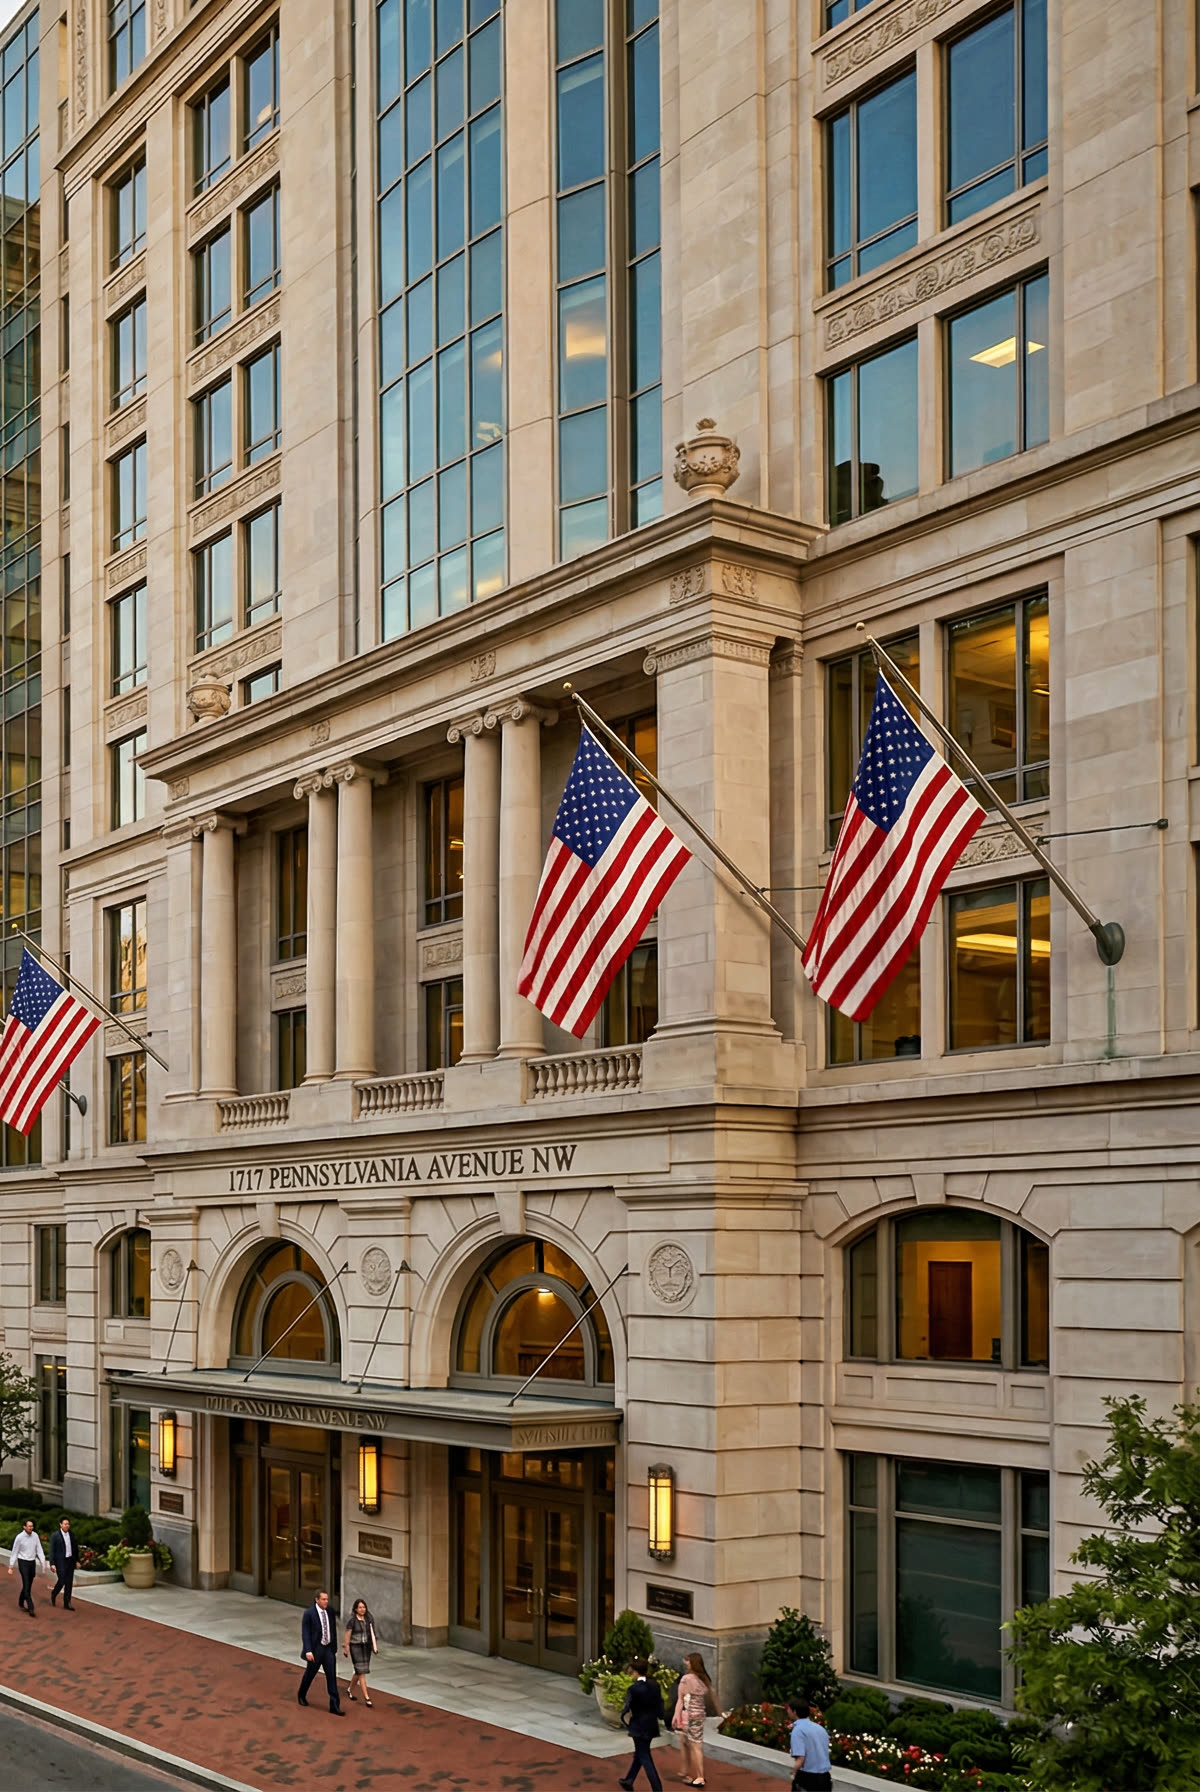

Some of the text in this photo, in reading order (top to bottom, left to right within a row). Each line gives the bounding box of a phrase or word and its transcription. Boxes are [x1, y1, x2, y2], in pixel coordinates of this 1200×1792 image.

[229, 1144, 578, 1191] 1717 PENNSYLVANIA AVENUE NW
